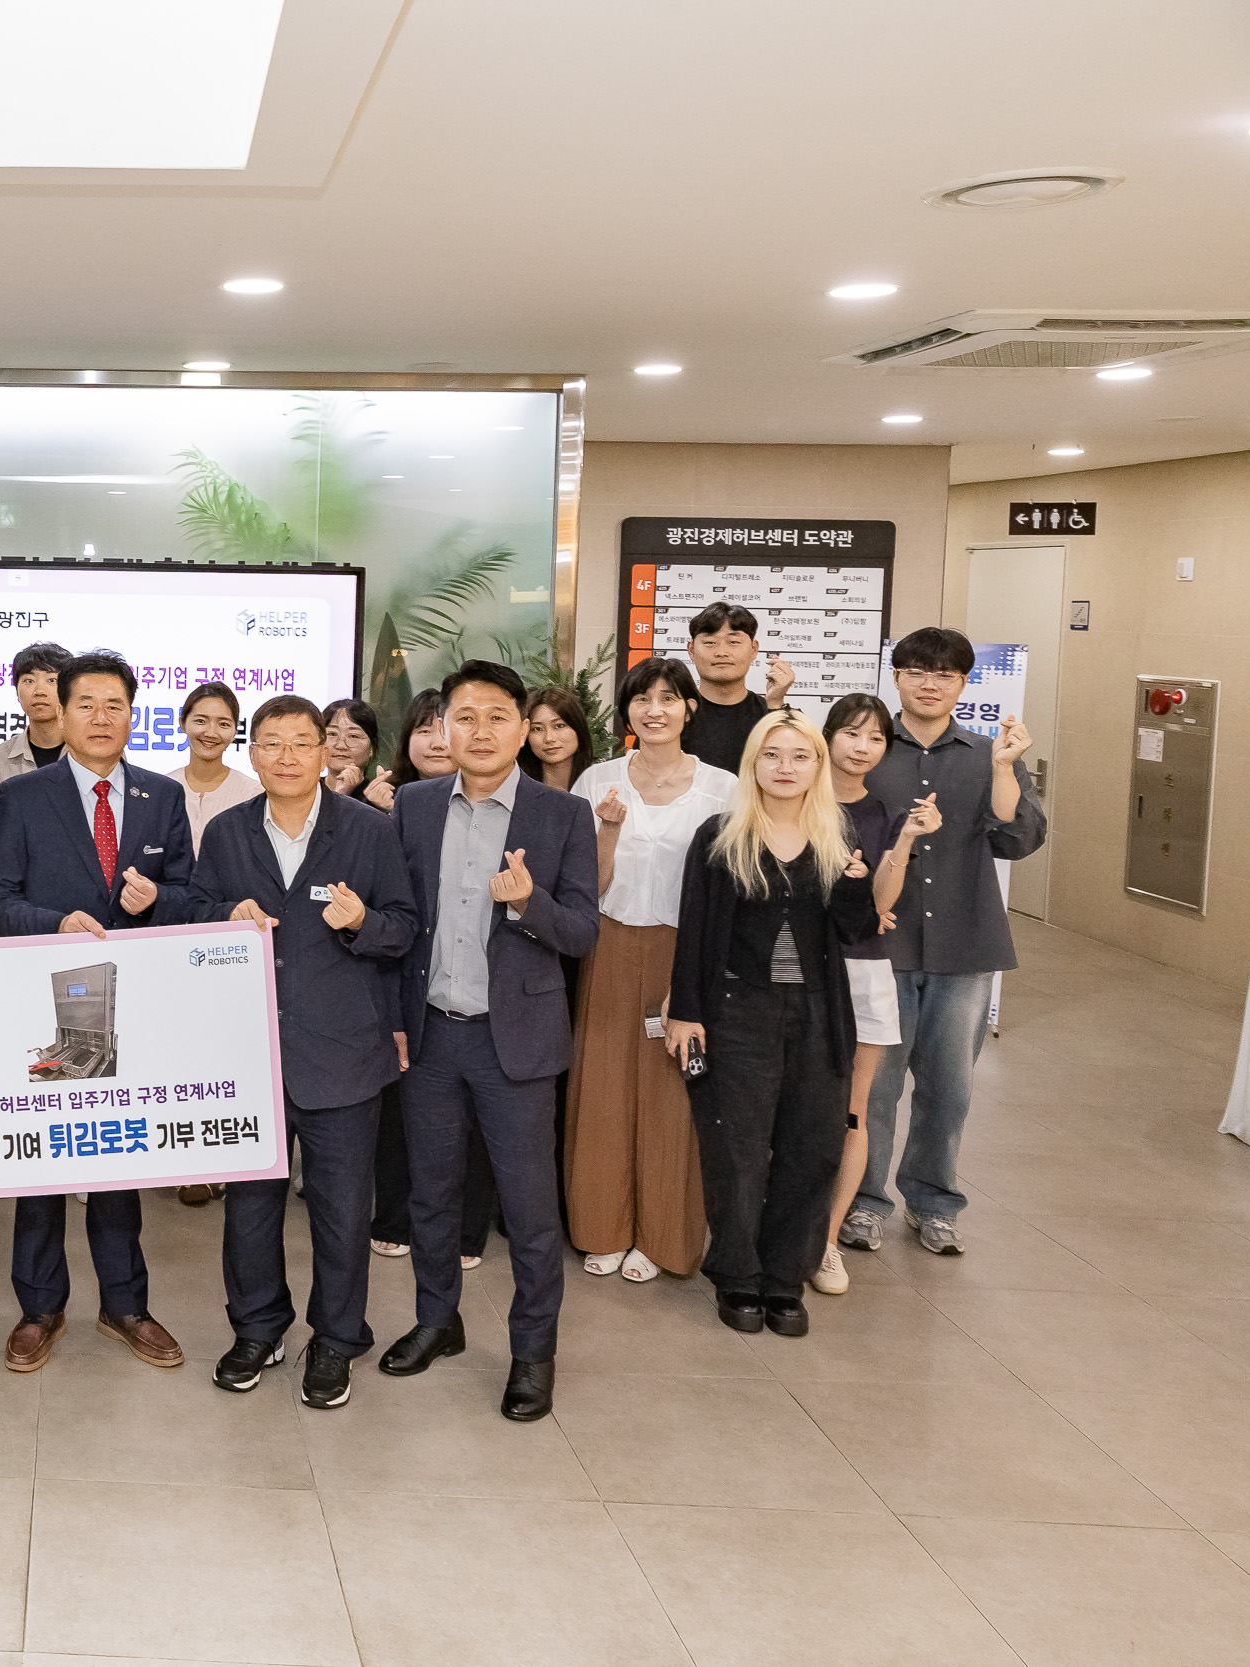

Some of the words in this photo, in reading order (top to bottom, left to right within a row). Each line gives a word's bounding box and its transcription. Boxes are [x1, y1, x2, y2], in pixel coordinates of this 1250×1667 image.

[666, 527, 798, 547] 광진경제허브센터
[803, 530, 854, 548] 도약관
[636, 579, 652, 591] 4F
[259, 611, 308, 623] HELPER
[258, 626, 308, 637] ROBOTICS
[634, 622, 650, 634] 3F
[232, 667, 295, 692] 연계사업
[955, 701, 1001, 722] 경영
[207, 945, 248, 956] HELPER
[208, 955, 249, 966] ROBOTICS
[68, 1087, 131, 1110] 입주기업
[137, 1085, 168, 1105] 구정
[173, 1080, 236, 1102] 연계사업
[2, 1131, 42, 1160] 기여
[48, 1117, 149, 1159] 튀김로봇
[156, 1120, 195, 1149] 기부
[200, 1115, 260, 1147] 전달식
